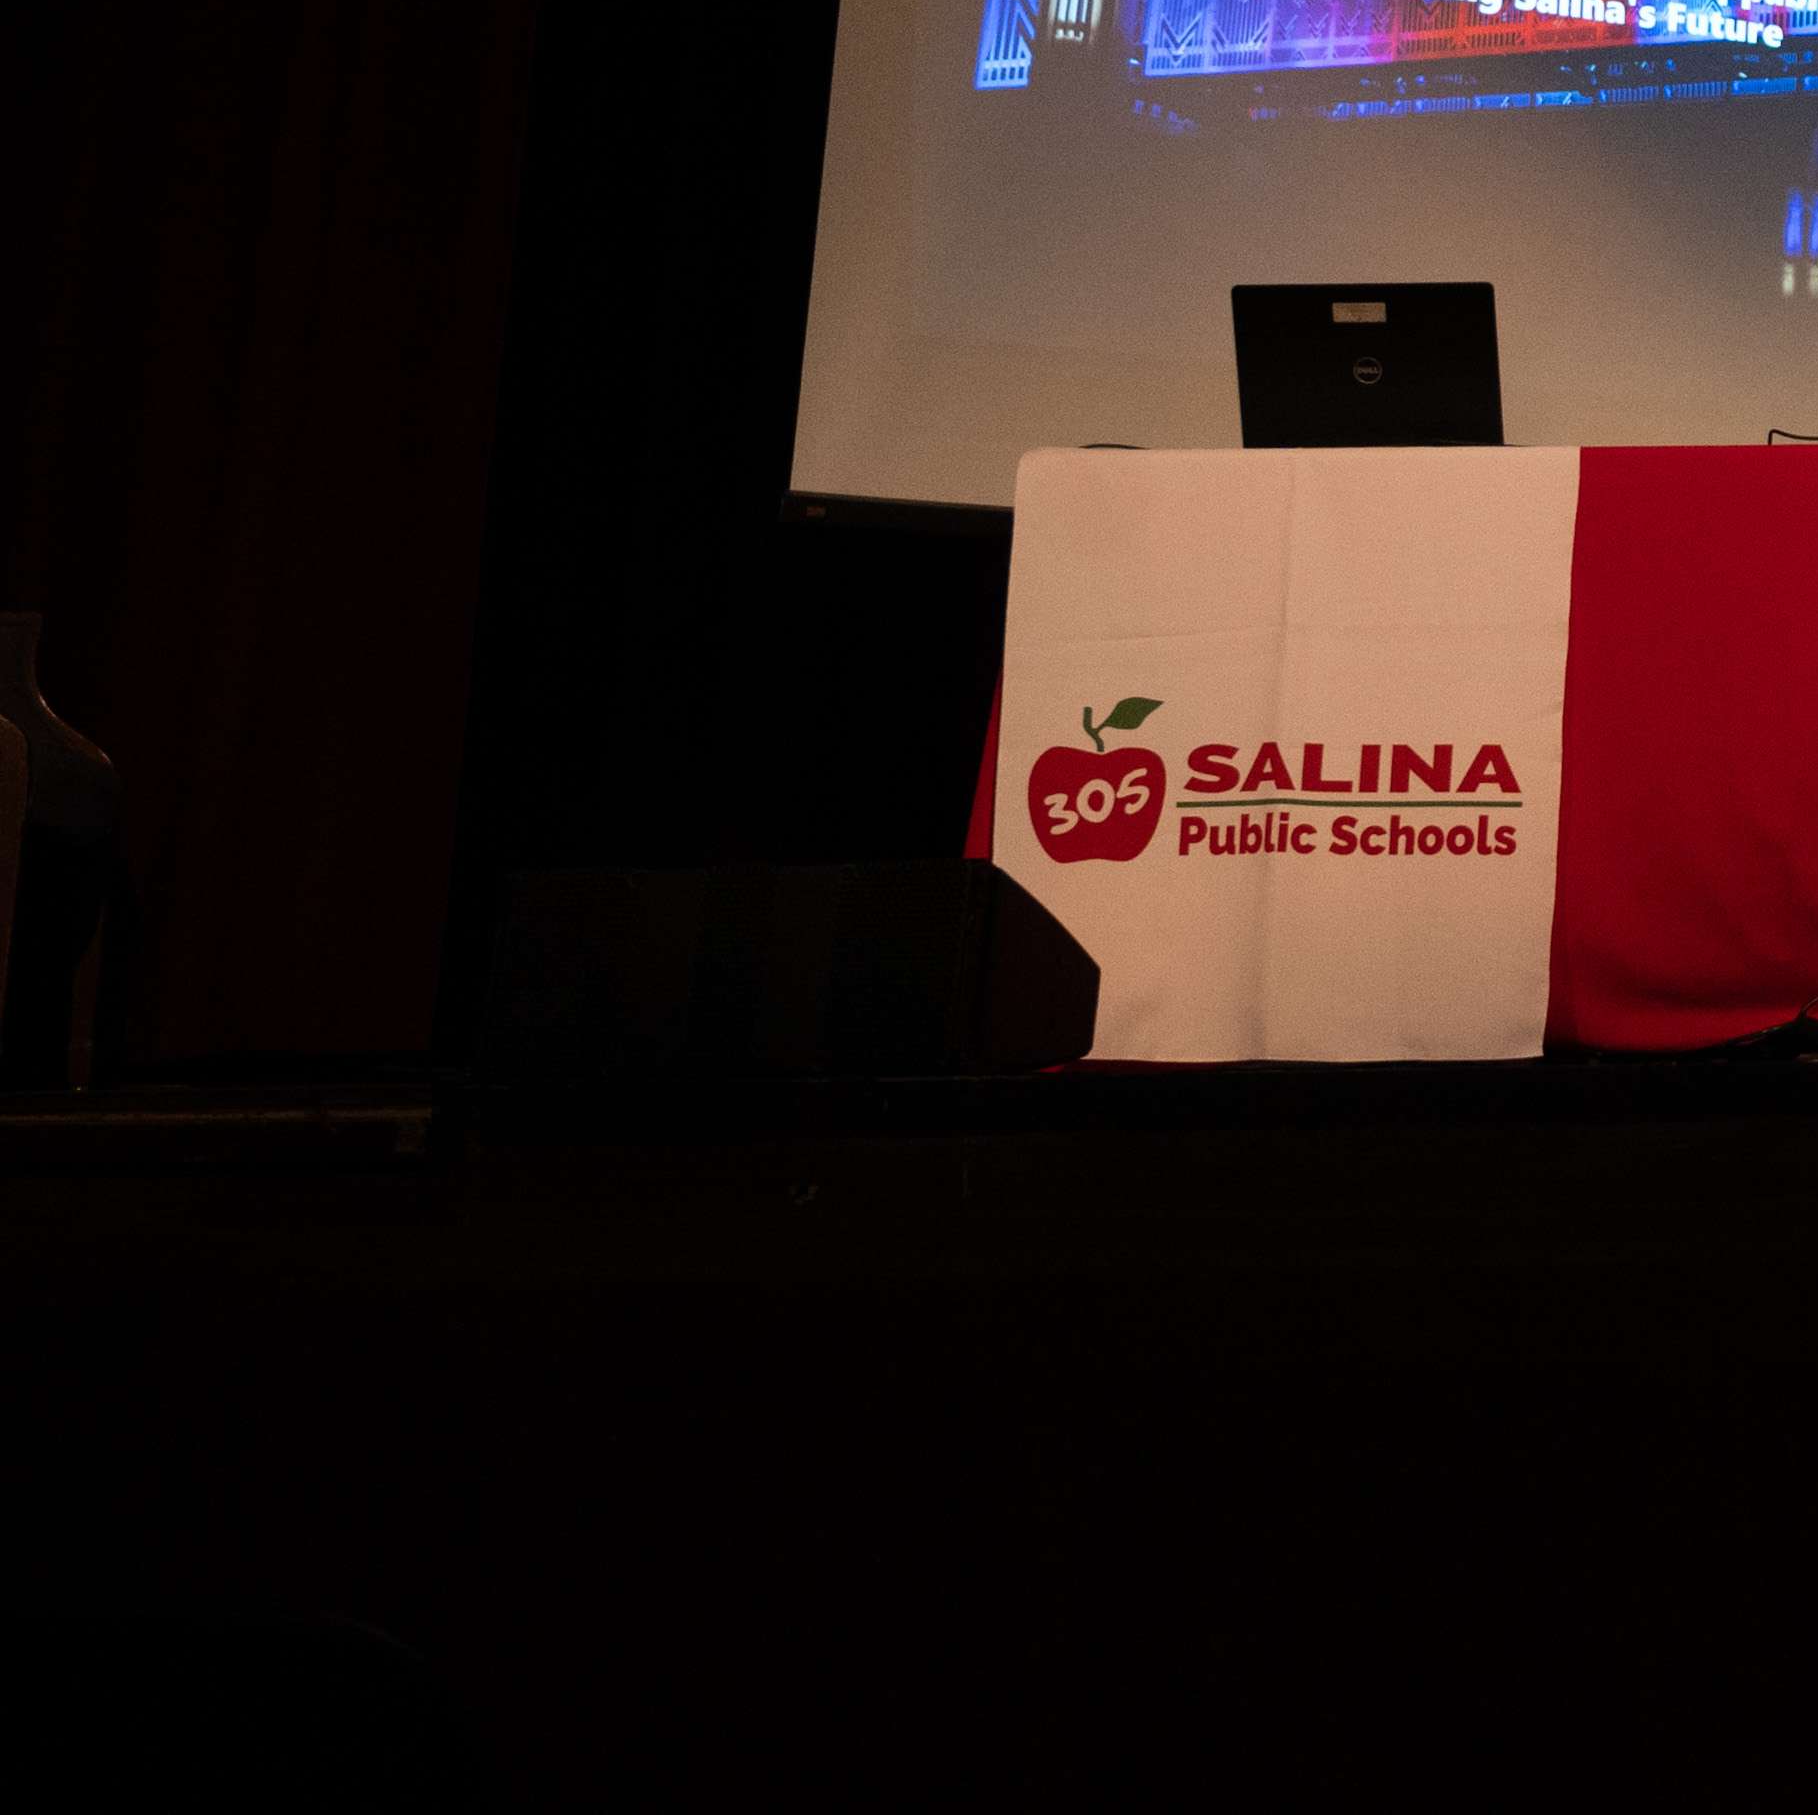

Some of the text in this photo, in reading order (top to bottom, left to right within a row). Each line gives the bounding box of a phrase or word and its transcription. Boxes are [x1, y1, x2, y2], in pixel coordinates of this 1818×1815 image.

[1667, 3, 1784, 48] Future
[1184, 742, 1522, 793] SALINA
[1044, 767, 1149, 835] 305
[1178, 811, 1517, 856] Public Schools
